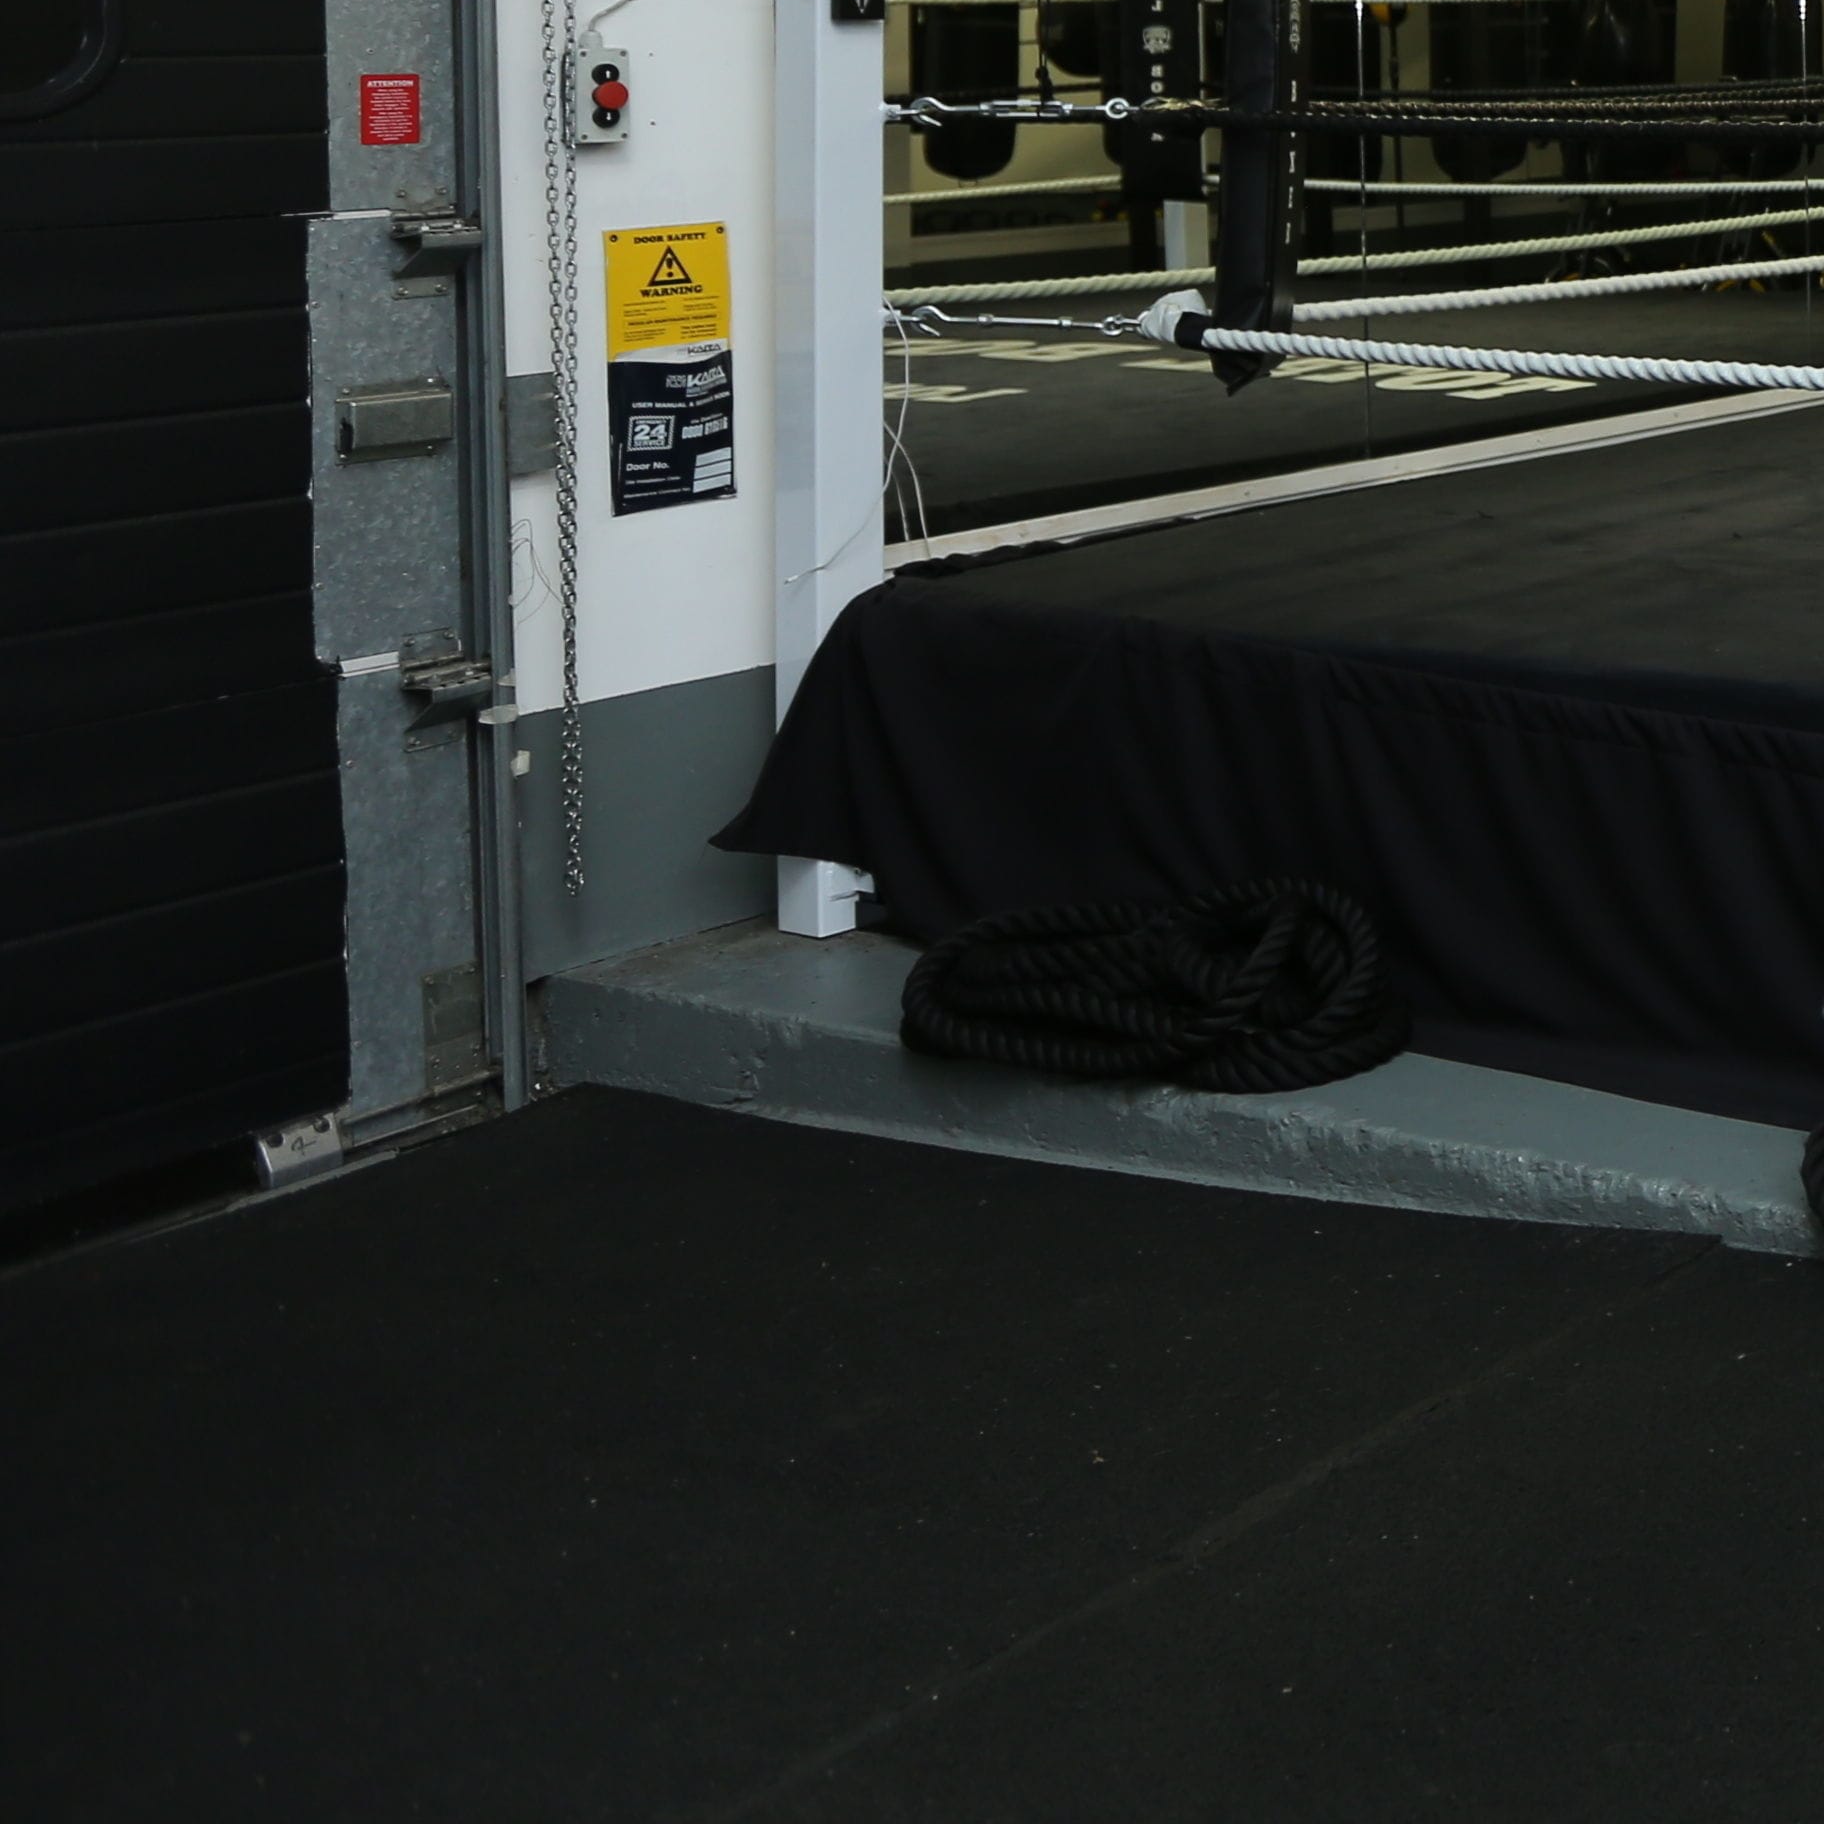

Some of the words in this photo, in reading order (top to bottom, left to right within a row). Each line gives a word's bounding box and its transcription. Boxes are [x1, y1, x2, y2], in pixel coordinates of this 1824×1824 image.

[640, 284, 703, 298] WARNING
[633, 424, 667, 441] 24
[625, 462, 651, 472] Door
